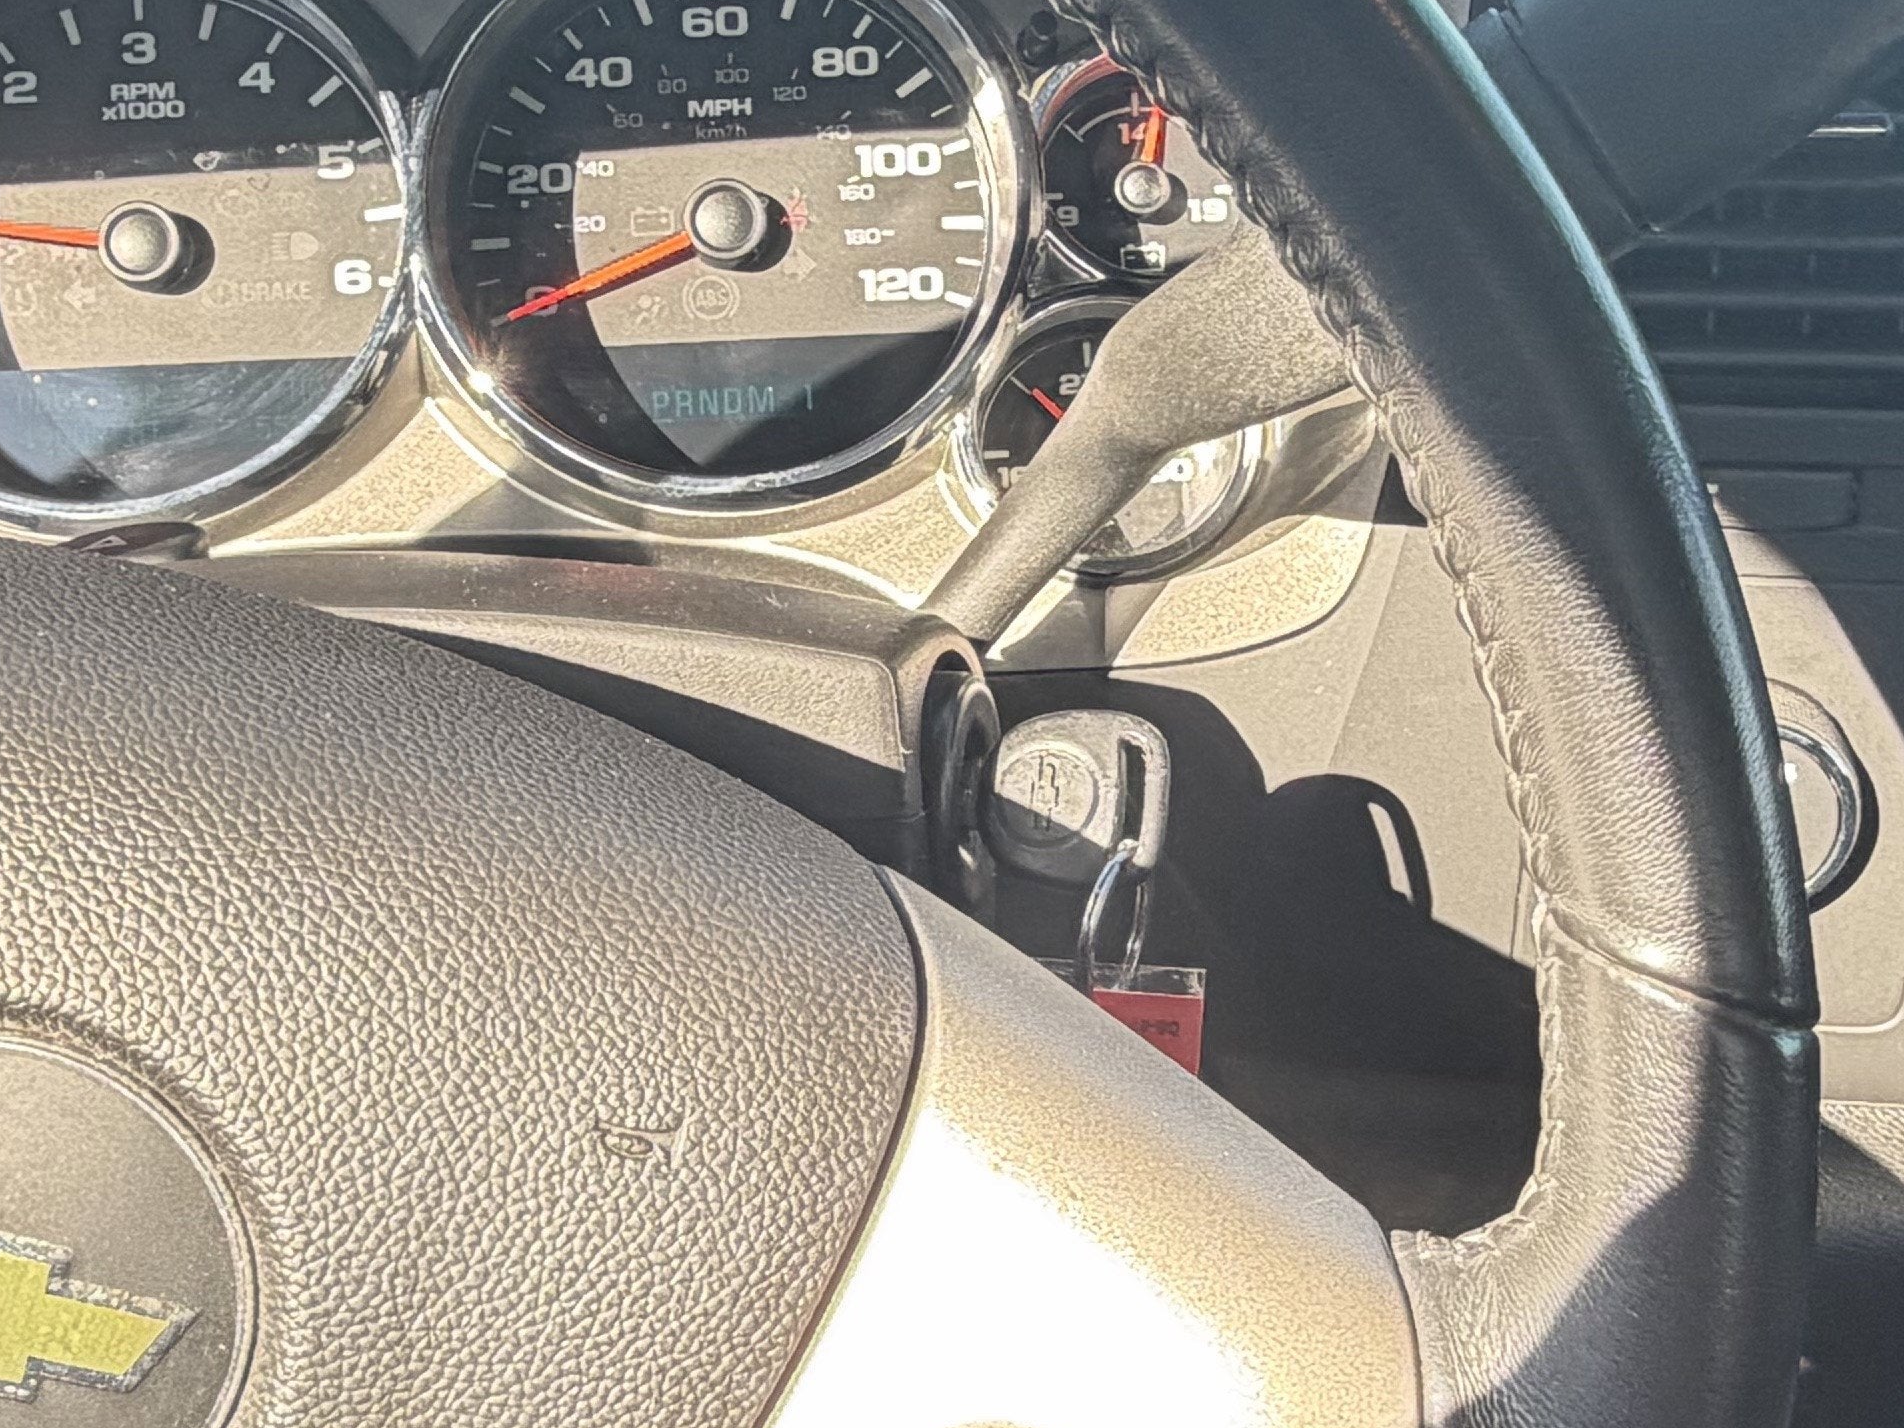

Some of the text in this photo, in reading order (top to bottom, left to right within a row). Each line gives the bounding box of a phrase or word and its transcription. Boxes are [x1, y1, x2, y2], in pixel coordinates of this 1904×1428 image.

[681, 6, 749, 38] 60
[121, 32, 157, 65] 3
[812, 45, 879, 78] 80
[2, 71, 38, 105] 2
[238, 62, 275, 94] 4
[565, 56, 633, 88] 40
[715, 68, 750, 84] 100
[109, 81, 176, 102] RPM
[687, 97, 752, 118] MPH
[772, 85, 808, 102] 120
[101, 100, 186, 121] x1000
[612, 113, 644, 129] 60
[315, 145, 356, 180] 5
[581, 160, 615, 178] 40
[854, 142, 942, 178] 100
[507, 162, 573, 195] 20
[574, 215, 606, 233] 20
[1057, 205, 1079, 226] 9
[1187, 197, 1228, 223] 19
[333, 259, 372, 295] 6
[858, 267, 944, 302] 120
